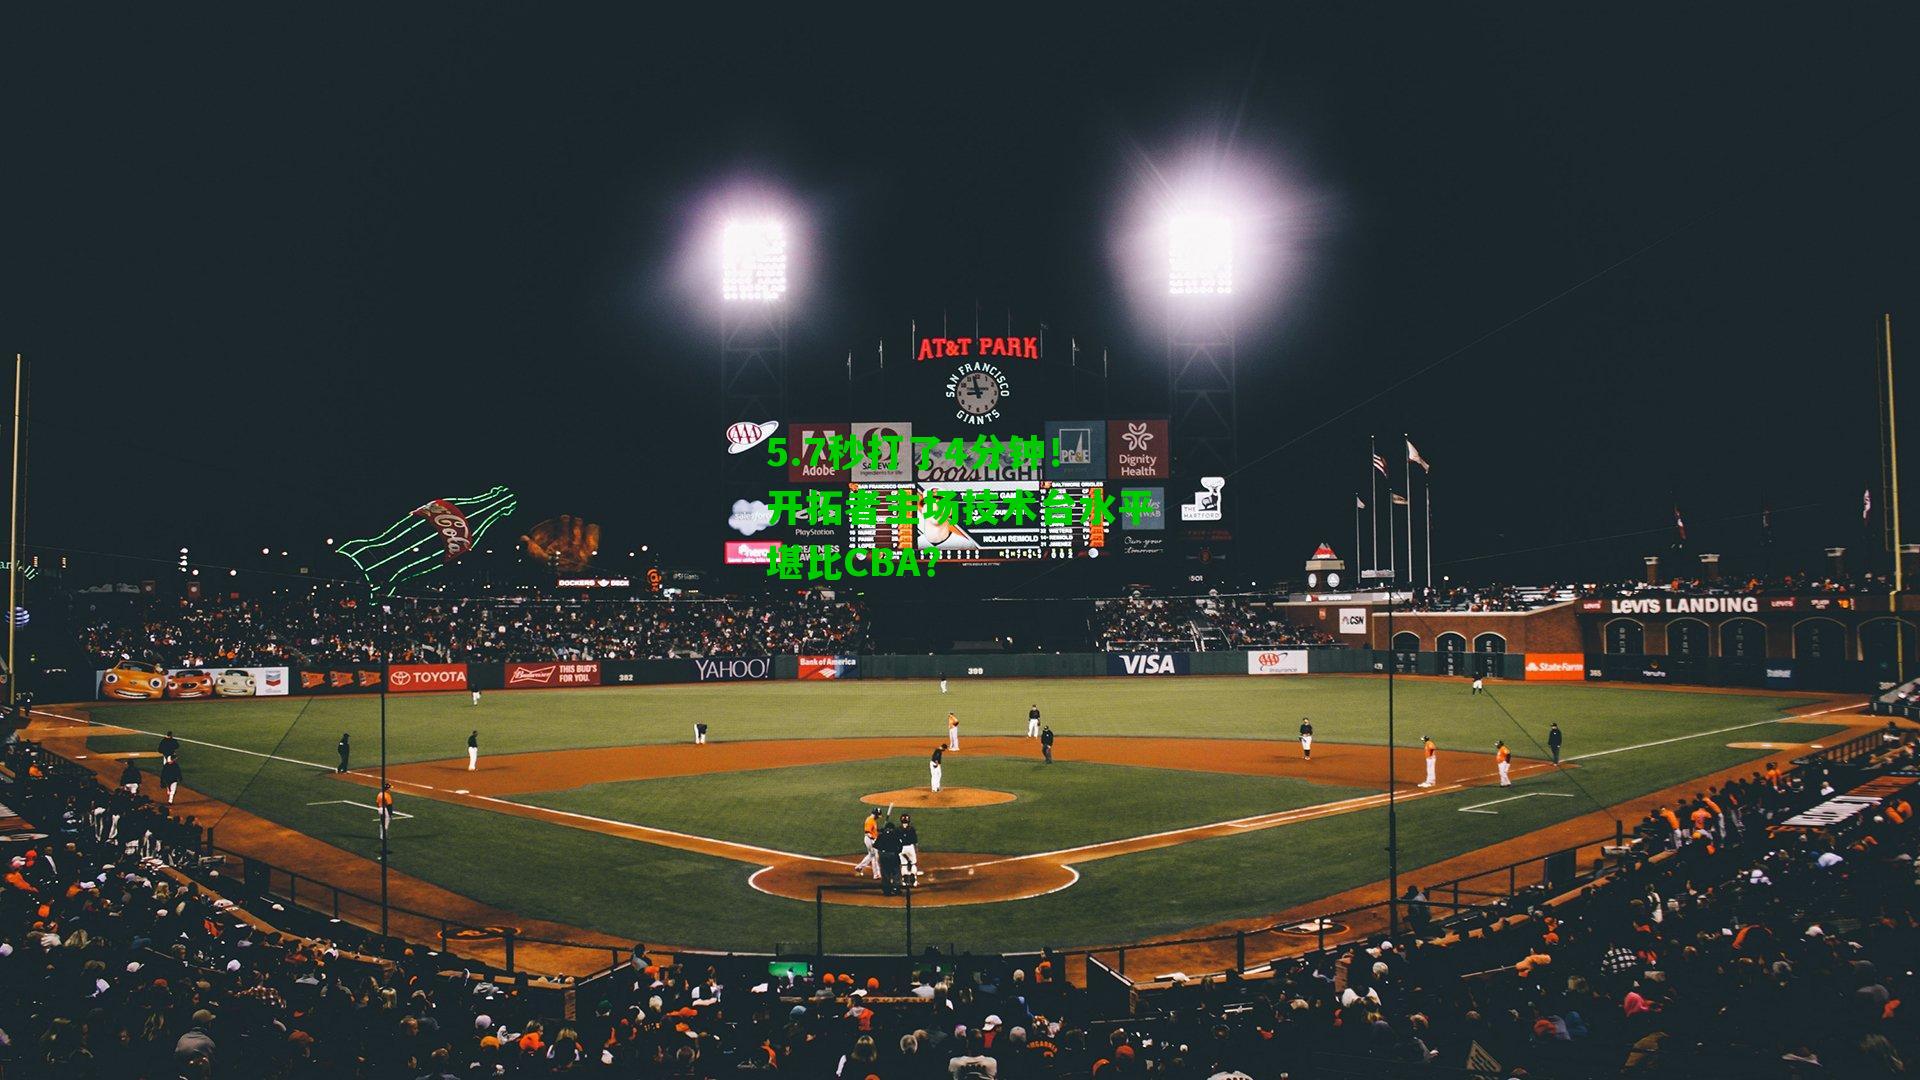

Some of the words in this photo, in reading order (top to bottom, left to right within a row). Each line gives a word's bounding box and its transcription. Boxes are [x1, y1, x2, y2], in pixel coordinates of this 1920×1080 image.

[917, 338, 972, 360] AT&T
[979, 337, 1038, 359] PARK
[945, 374, 960, 398] SAN
[958, 361, 1010, 397] FRANCISCO
[956, 408, 1000, 425] GIANTS
[1061, 449, 1090, 462] PG&E
[1119, 454, 1157, 466] Dignity
[802, 464, 836, 476] Adobe
[1121, 466, 1156, 477] Health
[734, 509, 773, 522] salesforc
[433, 513, 471, 555] Cola
[795, 528, 835, 538] PlayStation
[1666, 597, 1758, 613] LANDING
[1349, 616, 1364, 625] CSN
[800, 657, 818, 666] Bank
[818, 657, 826, 666] of
[826, 658, 857, 666] America
[1118, 654, 1176, 674] VISA
[515, 669, 551, 680] Budweiser
[559, 665, 575, 673] THIS
[576, 664, 598, 673] BUD'S
[695, 658, 771, 681] YAHOO!
[413, 671, 467, 683] TOYOTA
[559, 674, 573, 683] FOR
[573, 674, 590, 682] YOU.
